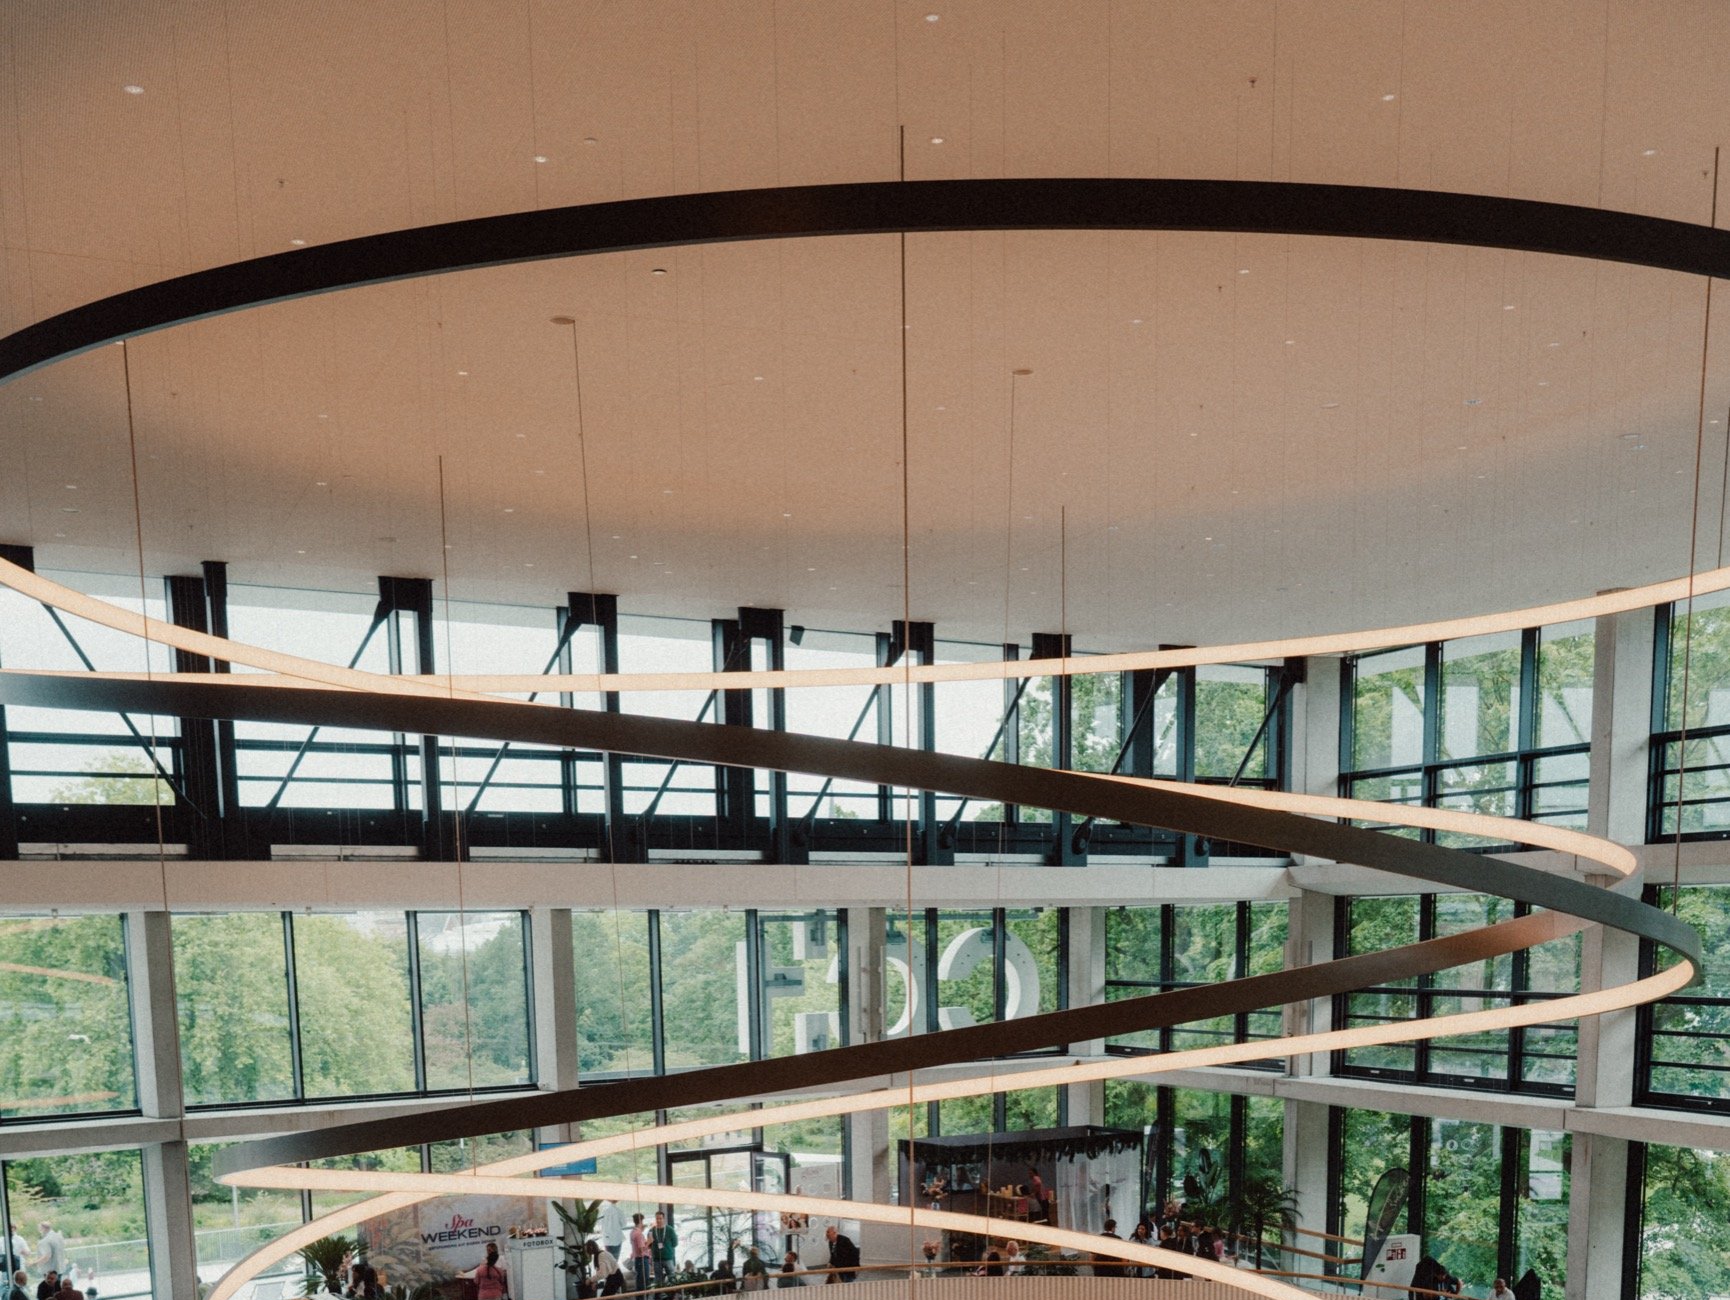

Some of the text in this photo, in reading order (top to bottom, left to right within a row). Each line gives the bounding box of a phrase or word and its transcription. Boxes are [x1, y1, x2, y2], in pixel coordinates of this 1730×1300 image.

[445, 1213, 474, 1233] Spa
[421, 1225, 501, 1244] WEEKEND
[523, 1239, 554, 1248] FOTOBOX
